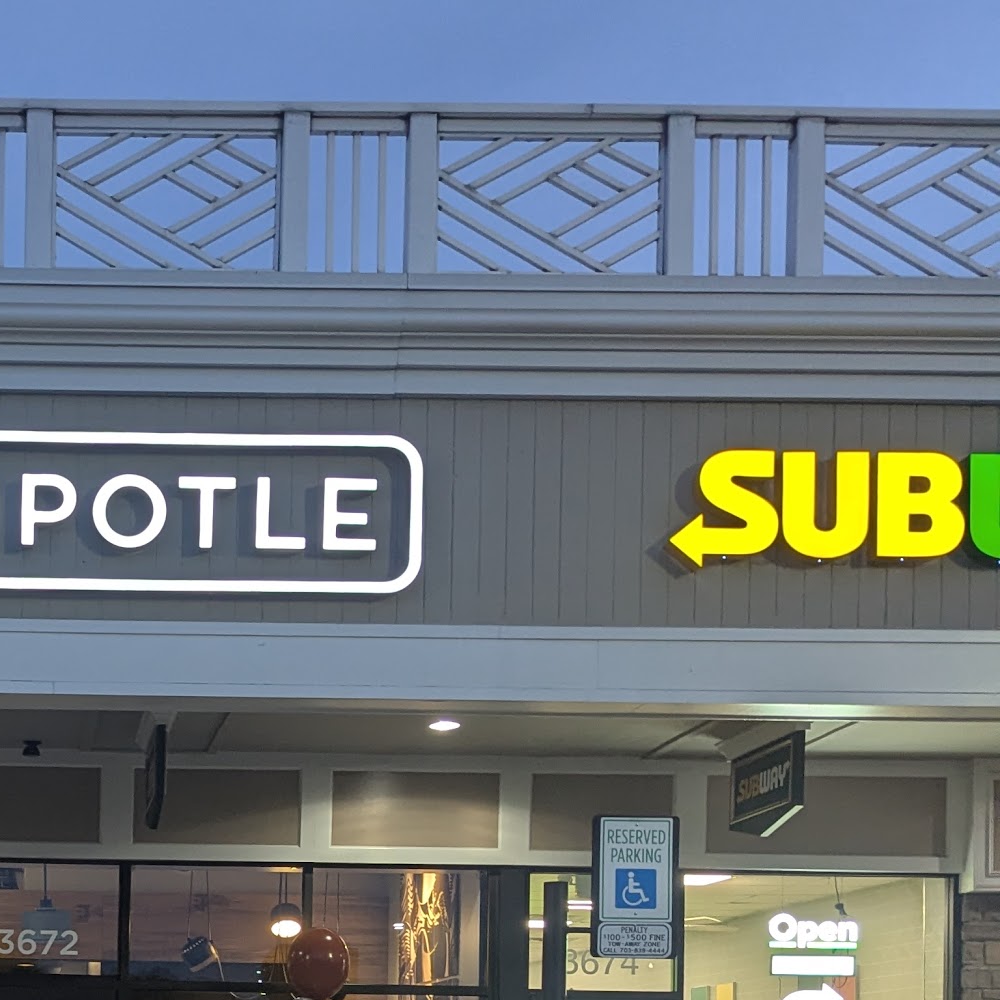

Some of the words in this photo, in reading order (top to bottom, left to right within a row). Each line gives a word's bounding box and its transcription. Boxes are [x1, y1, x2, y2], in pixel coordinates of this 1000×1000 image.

[737, 761, 790, 803] SUBWAY
[607, 829, 666, 845] RESERVED
[611, 848, 662, 863] PARKING
[768, 913, 859, 948] Open
